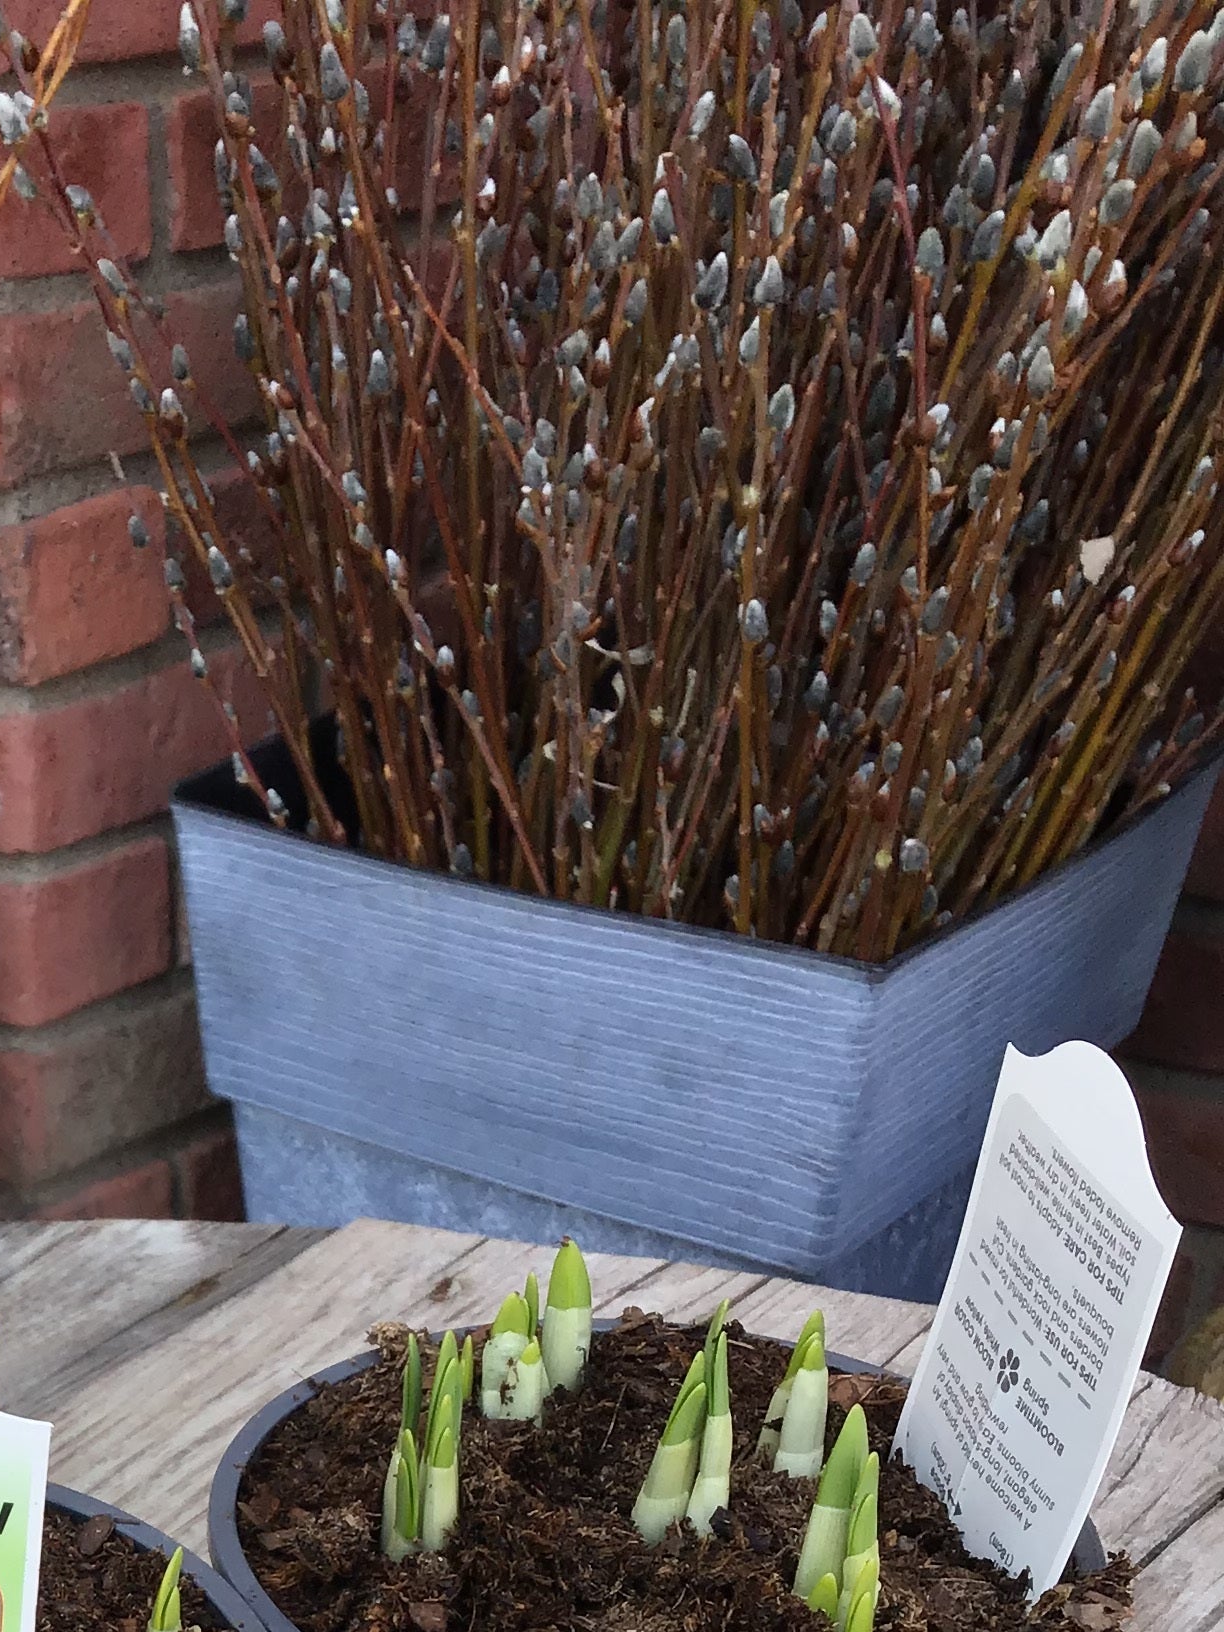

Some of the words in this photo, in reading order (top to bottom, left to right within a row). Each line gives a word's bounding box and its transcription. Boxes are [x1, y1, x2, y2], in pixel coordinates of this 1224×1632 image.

[1016, 1129, 1045, 1169] weather.
[1049, 1144, 1079, 1187] flowers.
[1008, 1141, 1051, 1197] well-drained
[1009, 1167, 1028, 1193] most
[1045, 1164, 1059, 1187] dry
[1027, 1188, 1036, 1206] to
[1058, 1180, 1068, 1197] in
[1066, 1189, 1090, 1223] freely
[1078, 1178, 1105, 1214] faded
[1035, 1198, 1063, 1238] Adapts
[1048, 1190, 1074, 1229] fertile,
[1074, 1221, 1083, 1238] in
[1083, 1231, 1103, 1259] Best
[1091, 1215, 1117, 1251] Water
[1104, 1206, 1141, 1251] Remove
[1061, 1231, 1087, 1265] CARE:
[1115, 1241, 1135, 1268] soil.
[1018, 1245, 1061, 1305] long-lasting
[1086, 1258, 1105, 1285] FOR
[1102, 1250, 1129, 1287] types.
[1032, 1288, 1051, 1315] rock
[1104, 1277, 1124, 1305] TIPS
[953, 1301, 974, 1339] COLOR
[1050, 1309, 1068, 1334] and
[1061, 1298, 1077, 1322] are
[1070, 1284, 1114, 1340] bouquets.
[972, 1332, 994, 1371] BLOOM
[1041, 1323, 1060, 1351] USE:
[1068, 1329, 1103, 1374] borders
[1076, 1316, 1109, 1357] flowers
[947, 1362, 960, 1386] and
[1059, 1343, 1078, 1371] FOR
[1077, 1363, 1096, 1391] TIPS
[1022, 1375, 1049, 1417] Spring
[1014, 1394, 1064, 1457] BLOOMTIME
[995, 1438, 1028, 1482] blooms.
[984, 1472, 1023, 1523] welcome
[1002, 1469, 1037, 1516] elegant,
[1028, 1478, 1054, 1513] sunny
[1022, 1517, 1032, 1534] A
